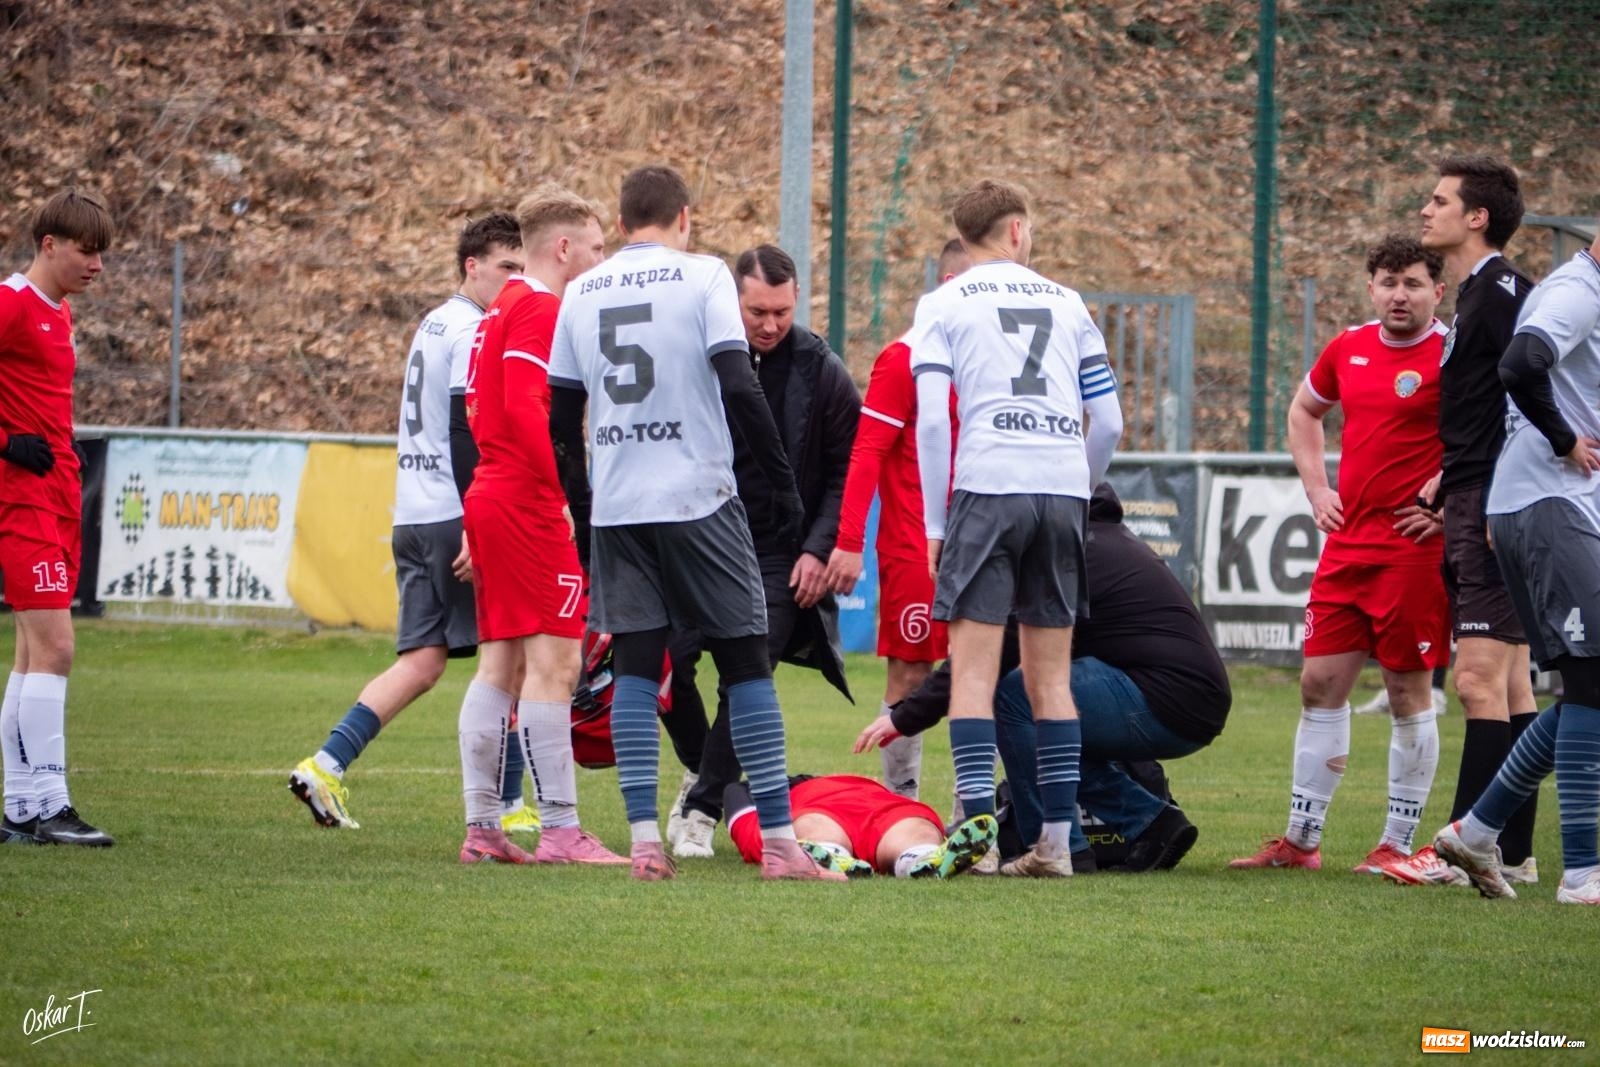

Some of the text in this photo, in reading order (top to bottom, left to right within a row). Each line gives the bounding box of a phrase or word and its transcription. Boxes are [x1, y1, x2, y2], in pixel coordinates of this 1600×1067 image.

[579, 267, 684, 296] 1908 NĘDZA
[960, 281, 1066, 298] 1908 NĘDZA
[599, 302, 656, 406] 5
[997, 306, 1053, 397] 7
[596, 420, 682, 446] EKO-TOX
[992, 411, 1083, 438] EKO-TOX
[397, 452, 442, 472] OTOX
[158, 490, 281, 533] MAN-TRANS
[32, 561, 69, 593] 13
[557, 573, 583, 618] 7
[900, 602, 931, 644] 6
[1563, 607, 1585, 642] 4
